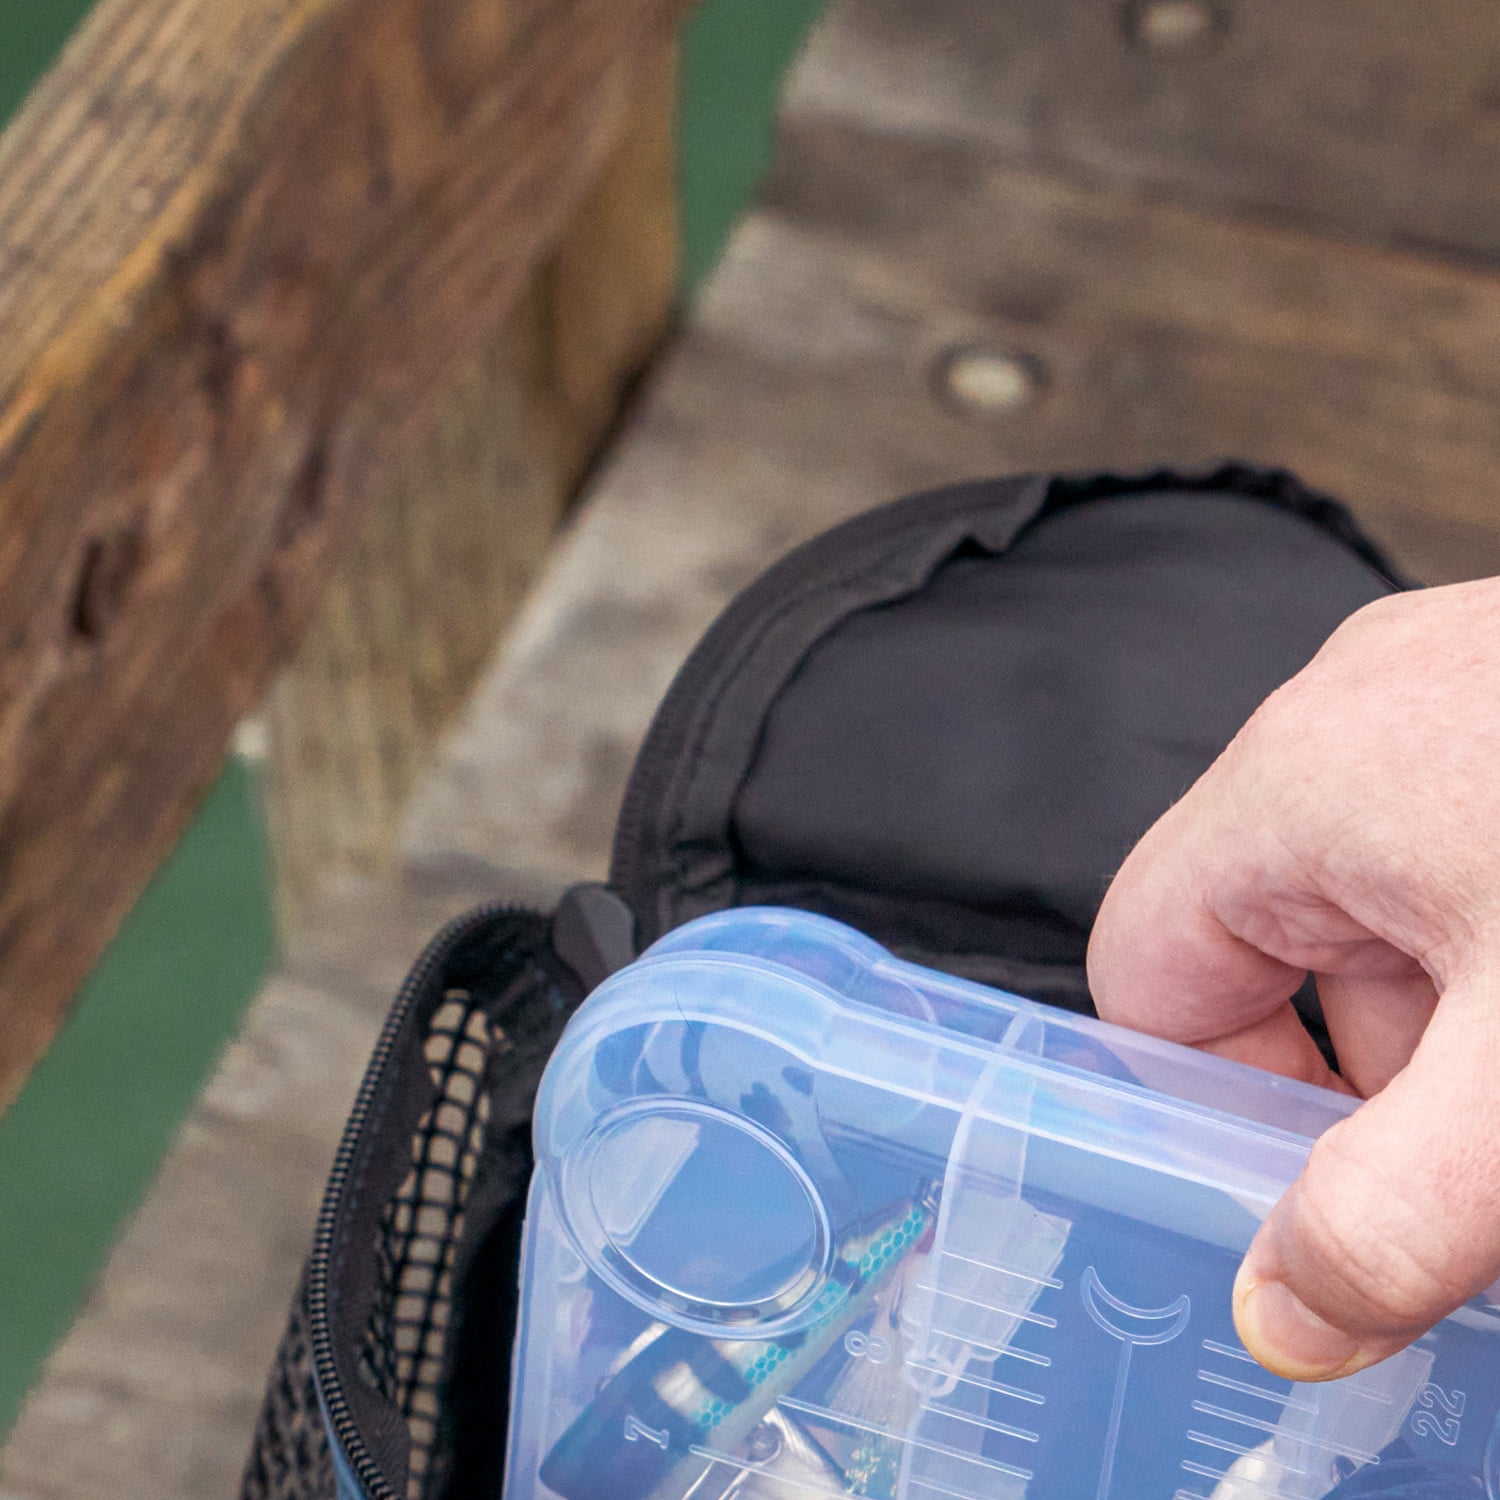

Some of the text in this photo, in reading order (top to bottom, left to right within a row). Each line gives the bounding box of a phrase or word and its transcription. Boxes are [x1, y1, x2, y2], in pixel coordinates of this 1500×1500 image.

[843, 1330, 891, 1364] 8
[623, 1414, 671, 1450] 7
[1411, 1382, 1466, 1446] 22
